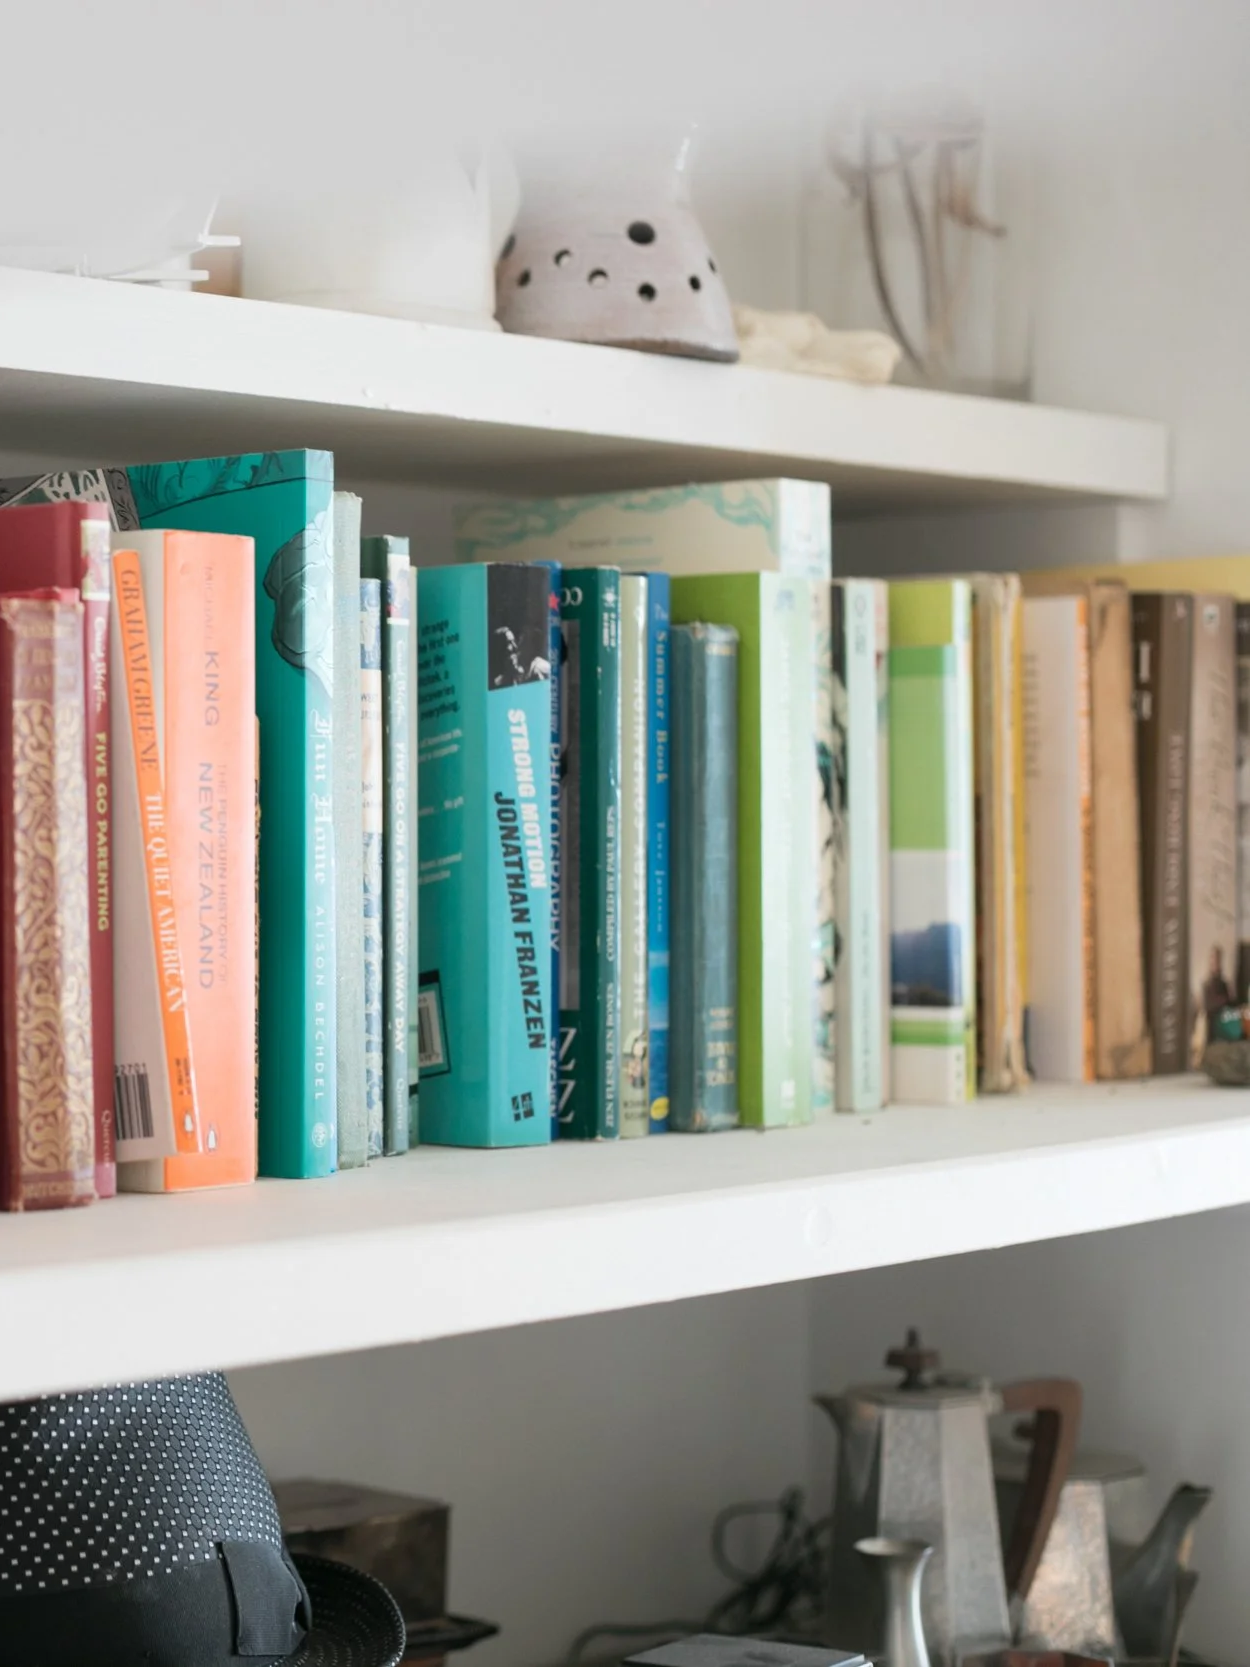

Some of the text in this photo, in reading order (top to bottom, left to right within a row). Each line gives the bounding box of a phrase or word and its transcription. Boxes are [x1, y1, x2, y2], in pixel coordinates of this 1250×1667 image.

[204, 650, 220, 727] KING
[655, 631, 667, 721] Summer
[217, 763, 228, 795] THE
[395, 743, 405, 782] FIVE
[655, 730, 668, 785] Book
[120, 569, 187, 1013] GRAHAM GREENE THE QUIET AMERICAN
[395, 786, 405, 816] GO
[507, 708, 548, 889] STRONG MOTION
[95, 733, 110, 931] FIVE GO PARENTING
[217, 798, 228, 878] PENGUIN
[395, 819, 405, 847] ON
[606, 806, 615, 838] REPS
[198, 762, 215, 990] NEW ZEALAND
[606, 843, 615, 873] PAUL
[217, 882, 228, 959] HISTORY
[310, 709, 333, 1100] Fun Home ALISON BECHDEL
[395, 868, 405, 959] STRATEGY
[494, 791, 547, 1049] JONATHAN FRANZEN
[606, 894, 615, 962] COMPILED
[395, 962, 405, 1015] AWAY
[605, 982, 615, 1026] BONES
[395, 1017, 406, 1055] DAY
[605, 1029, 615, 1054] ZEN
[605, 1055, 616, 1099] FLESH,
[605, 1101, 615, 1128] ZEN
